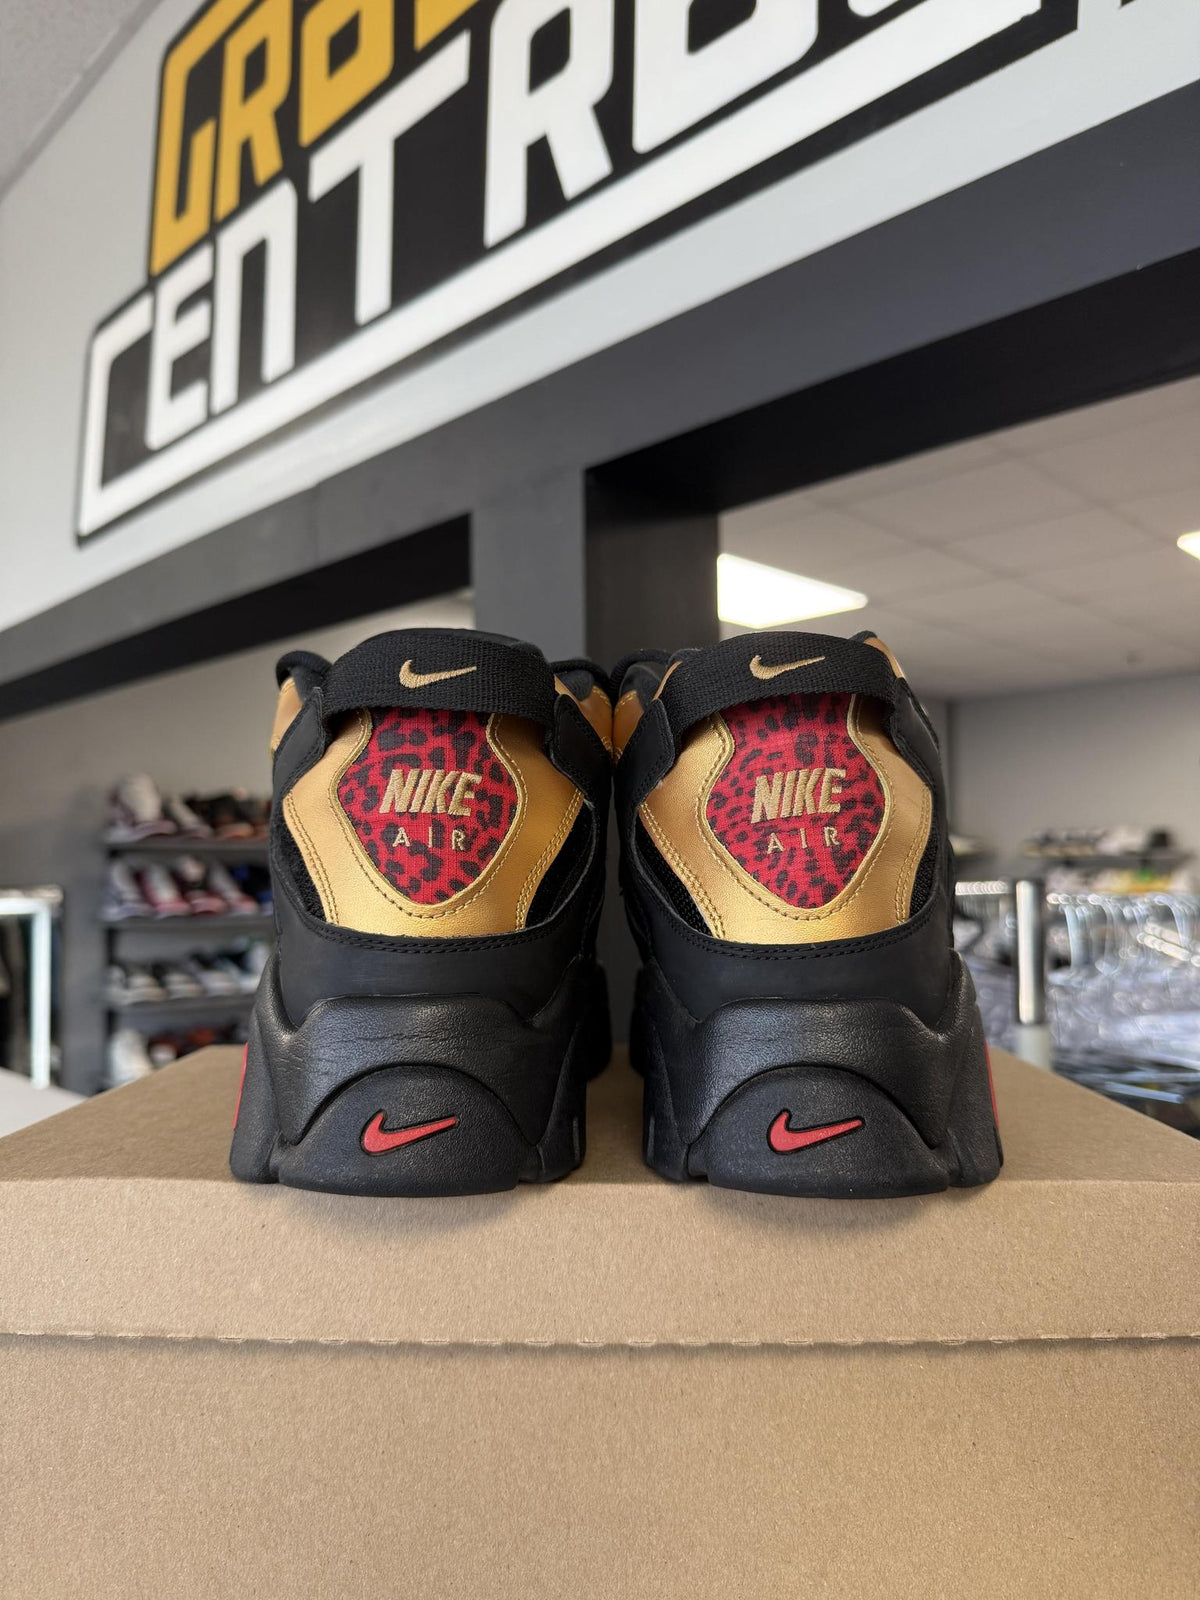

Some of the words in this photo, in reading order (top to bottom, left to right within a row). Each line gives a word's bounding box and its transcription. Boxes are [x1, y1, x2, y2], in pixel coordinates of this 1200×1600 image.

[150, 0, 480, 277] GRO
[379, 769, 482, 816] NIKE
[751, 768, 846, 823] NIKE
[392, 827, 466, 850] AIR
[767, 826, 840, 854] AIR
